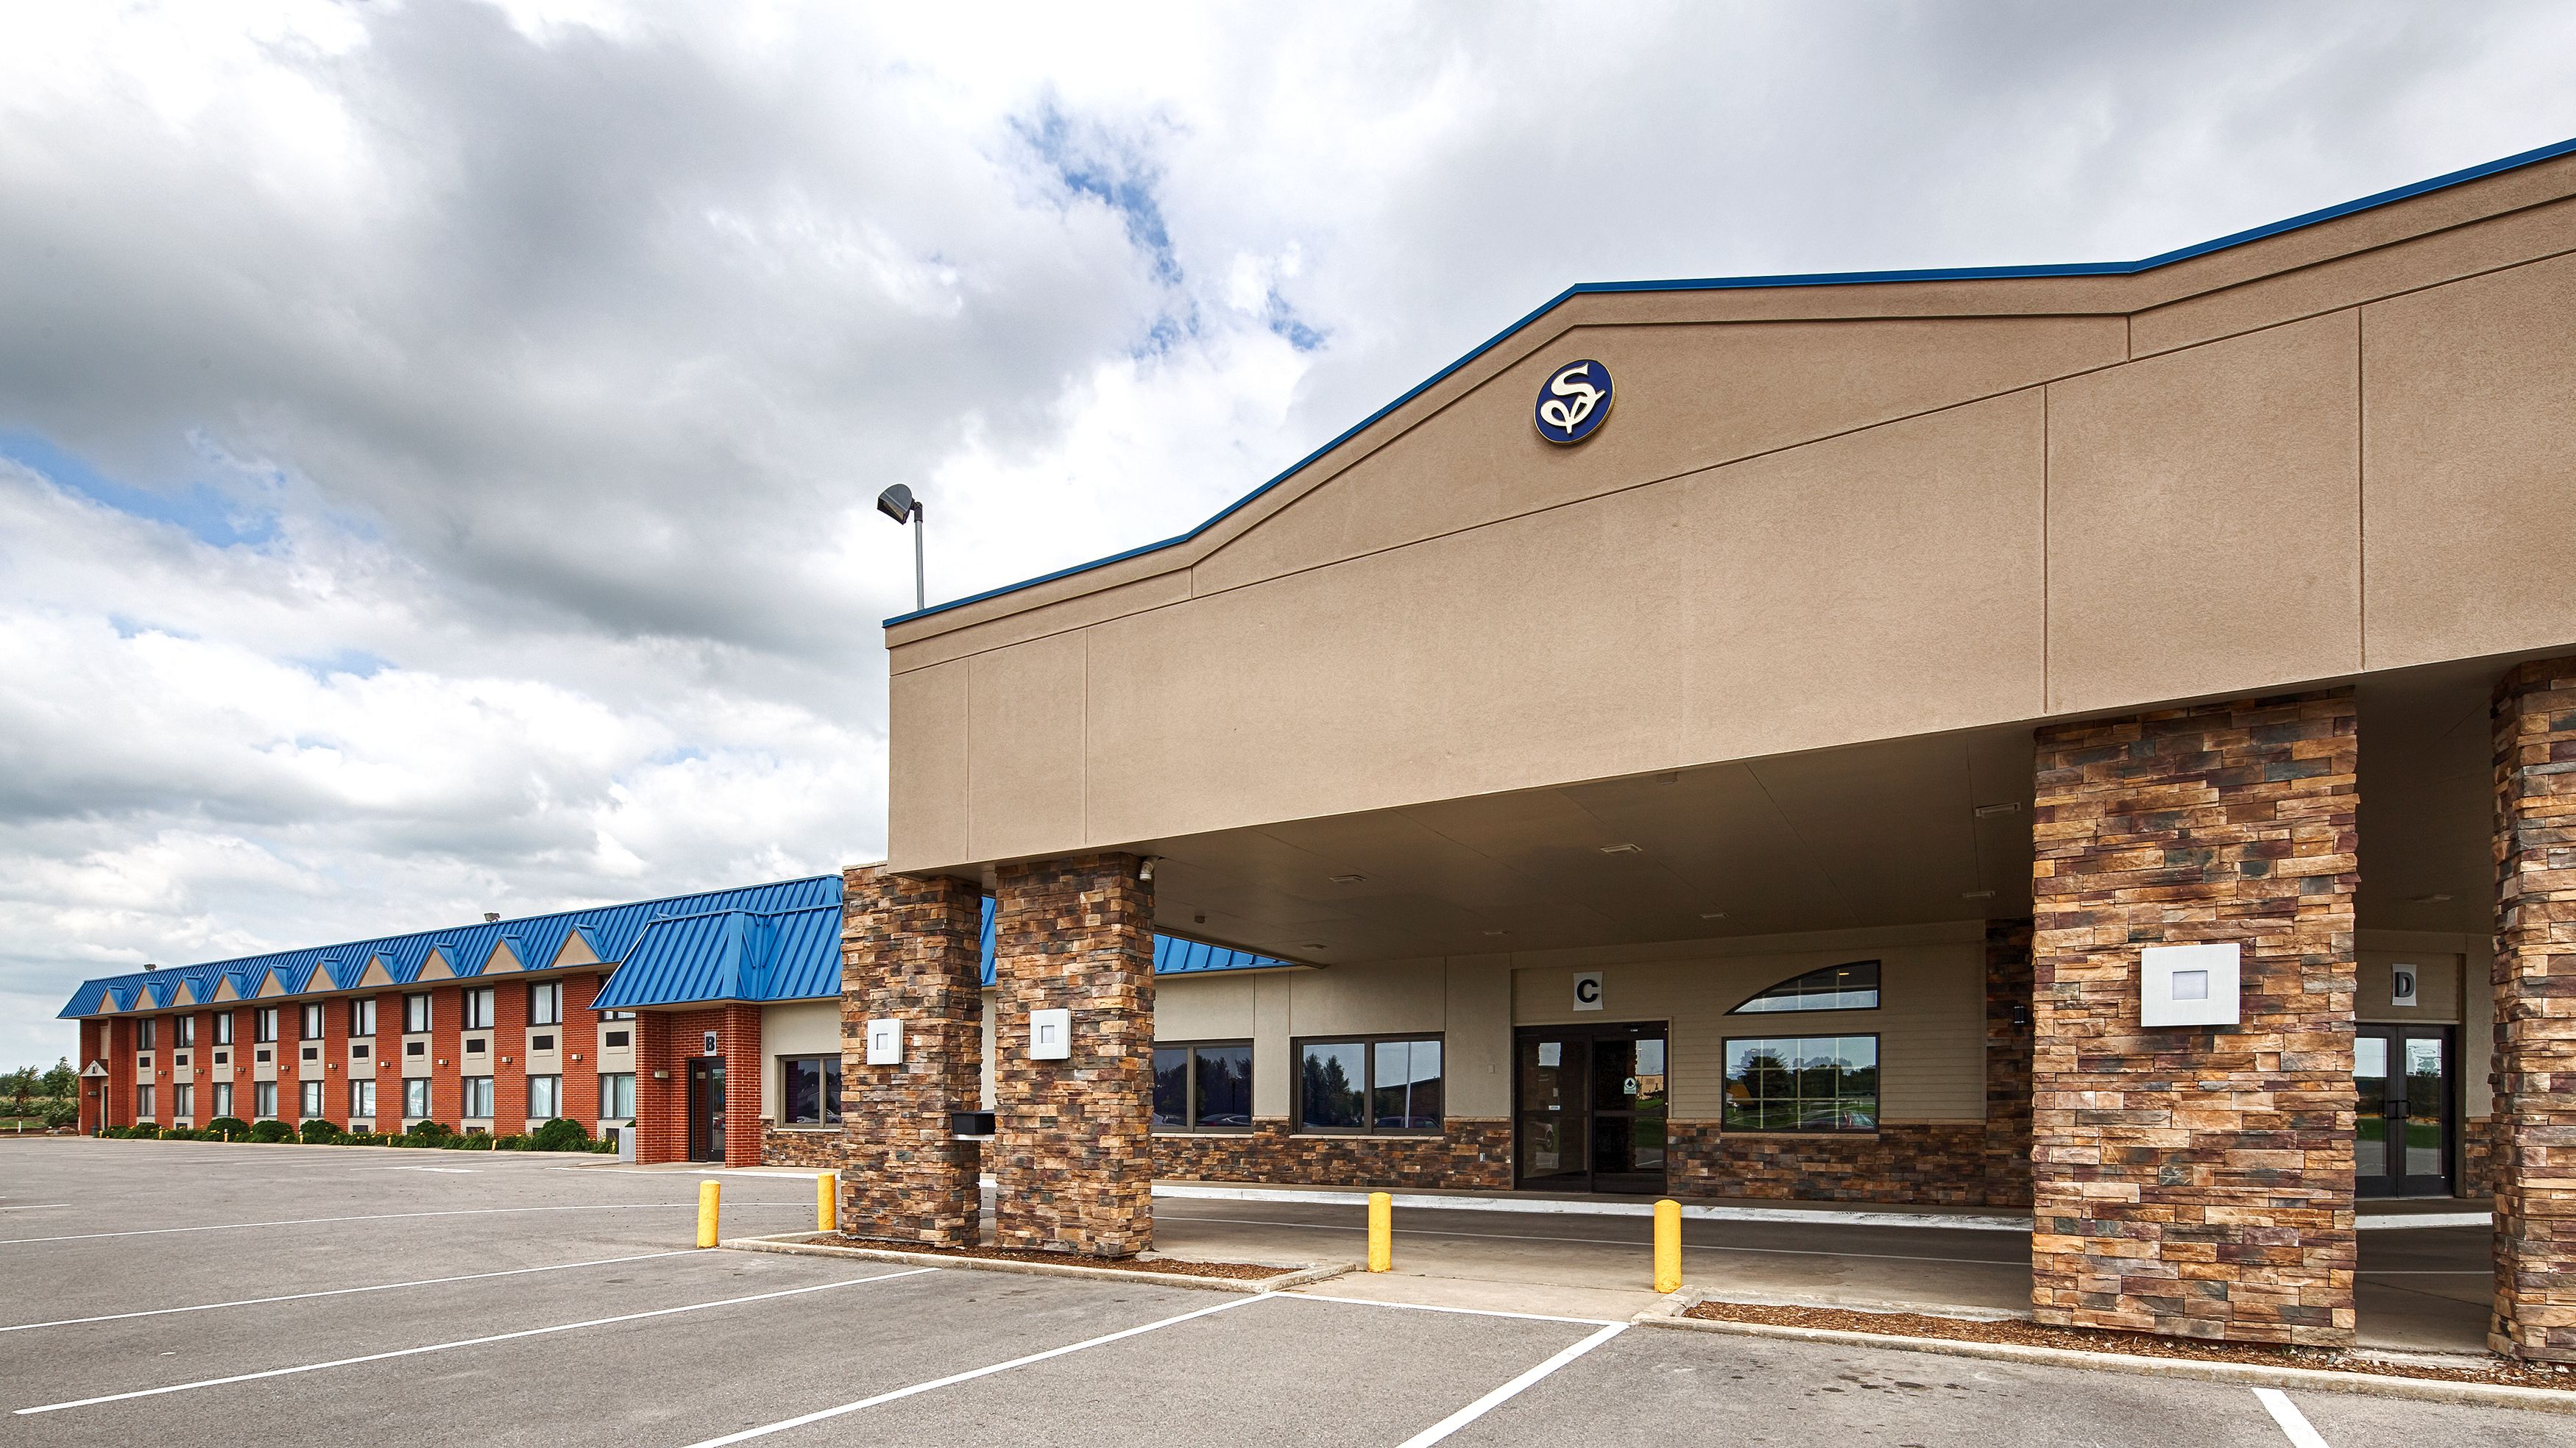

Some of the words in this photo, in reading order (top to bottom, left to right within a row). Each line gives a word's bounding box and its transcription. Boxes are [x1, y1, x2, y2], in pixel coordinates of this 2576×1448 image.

[1577, 979, 1599, 1003] C
[2394, 972, 2415, 998] D
[705, 1036, 715, 1051] B
